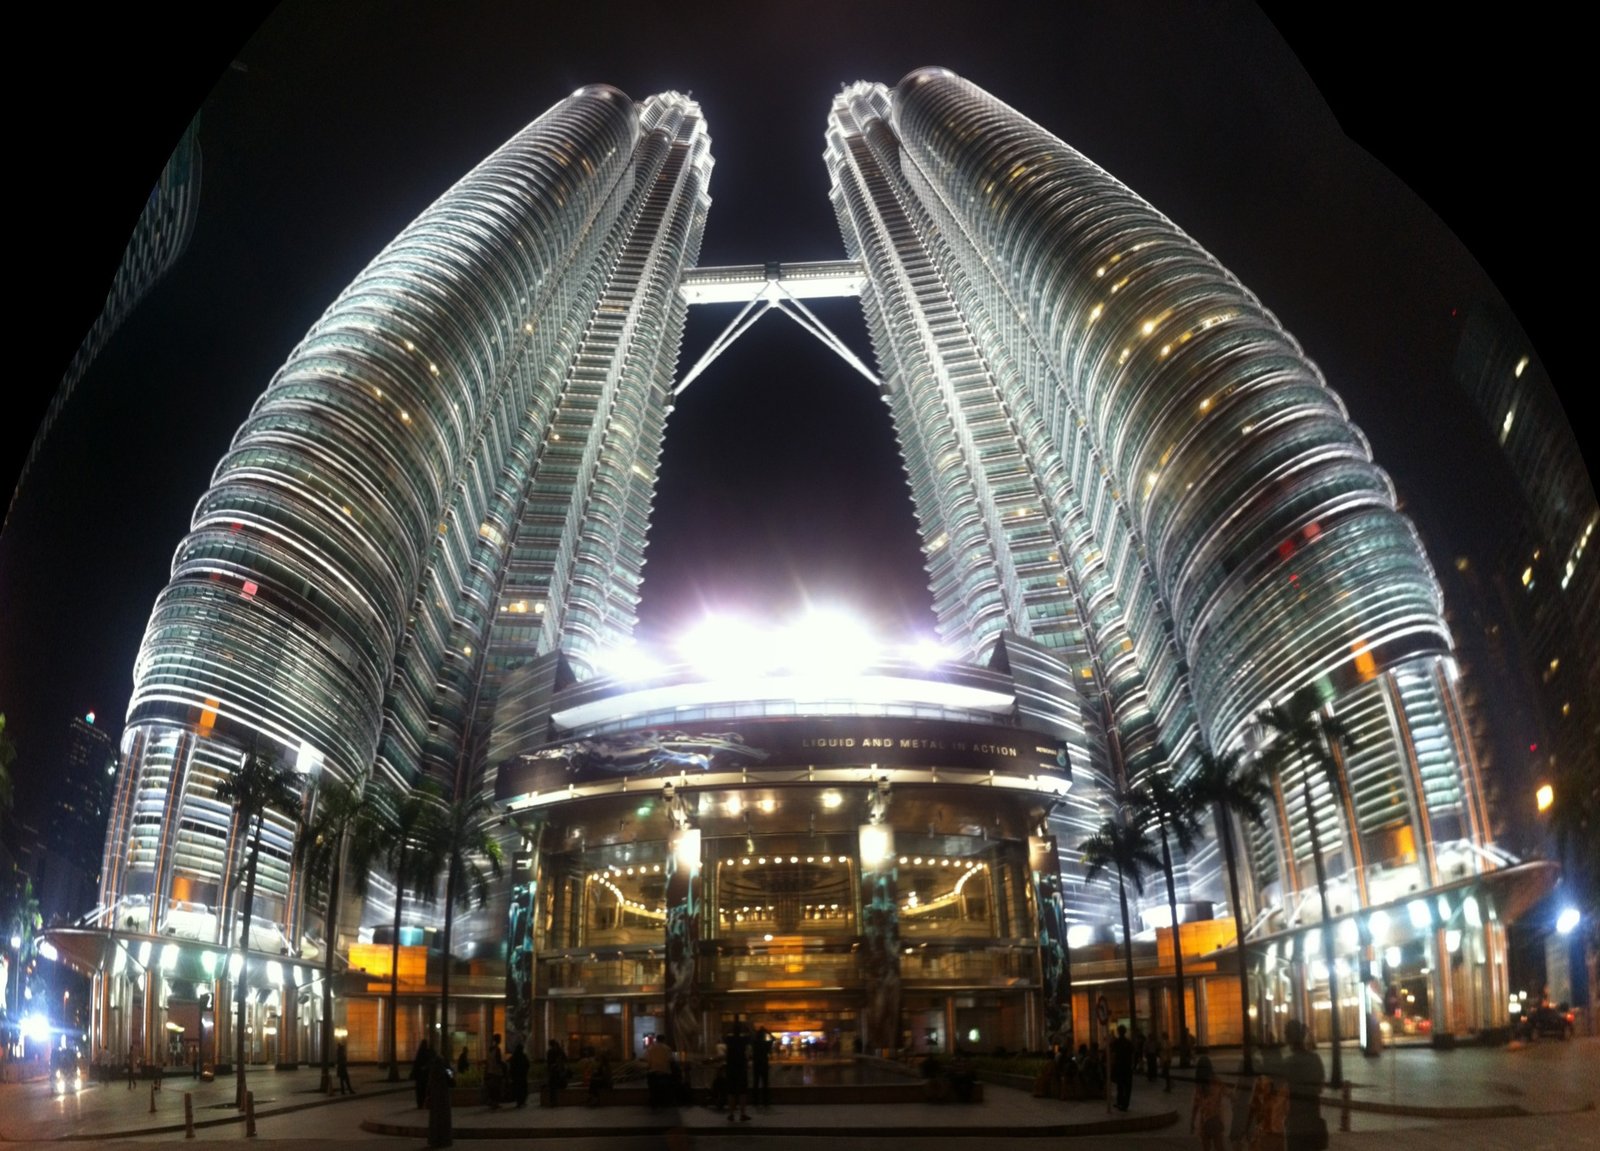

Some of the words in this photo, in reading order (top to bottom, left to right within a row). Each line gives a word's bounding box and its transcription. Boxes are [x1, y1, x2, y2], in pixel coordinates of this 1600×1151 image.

[802, 738, 855, 748] LIQUID
[862, 738, 892, 748] AND
[900, 739, 945, 750] METAL
[952, 742, 966, 752] IN
[973, 743, 1018, 757] ACTION
